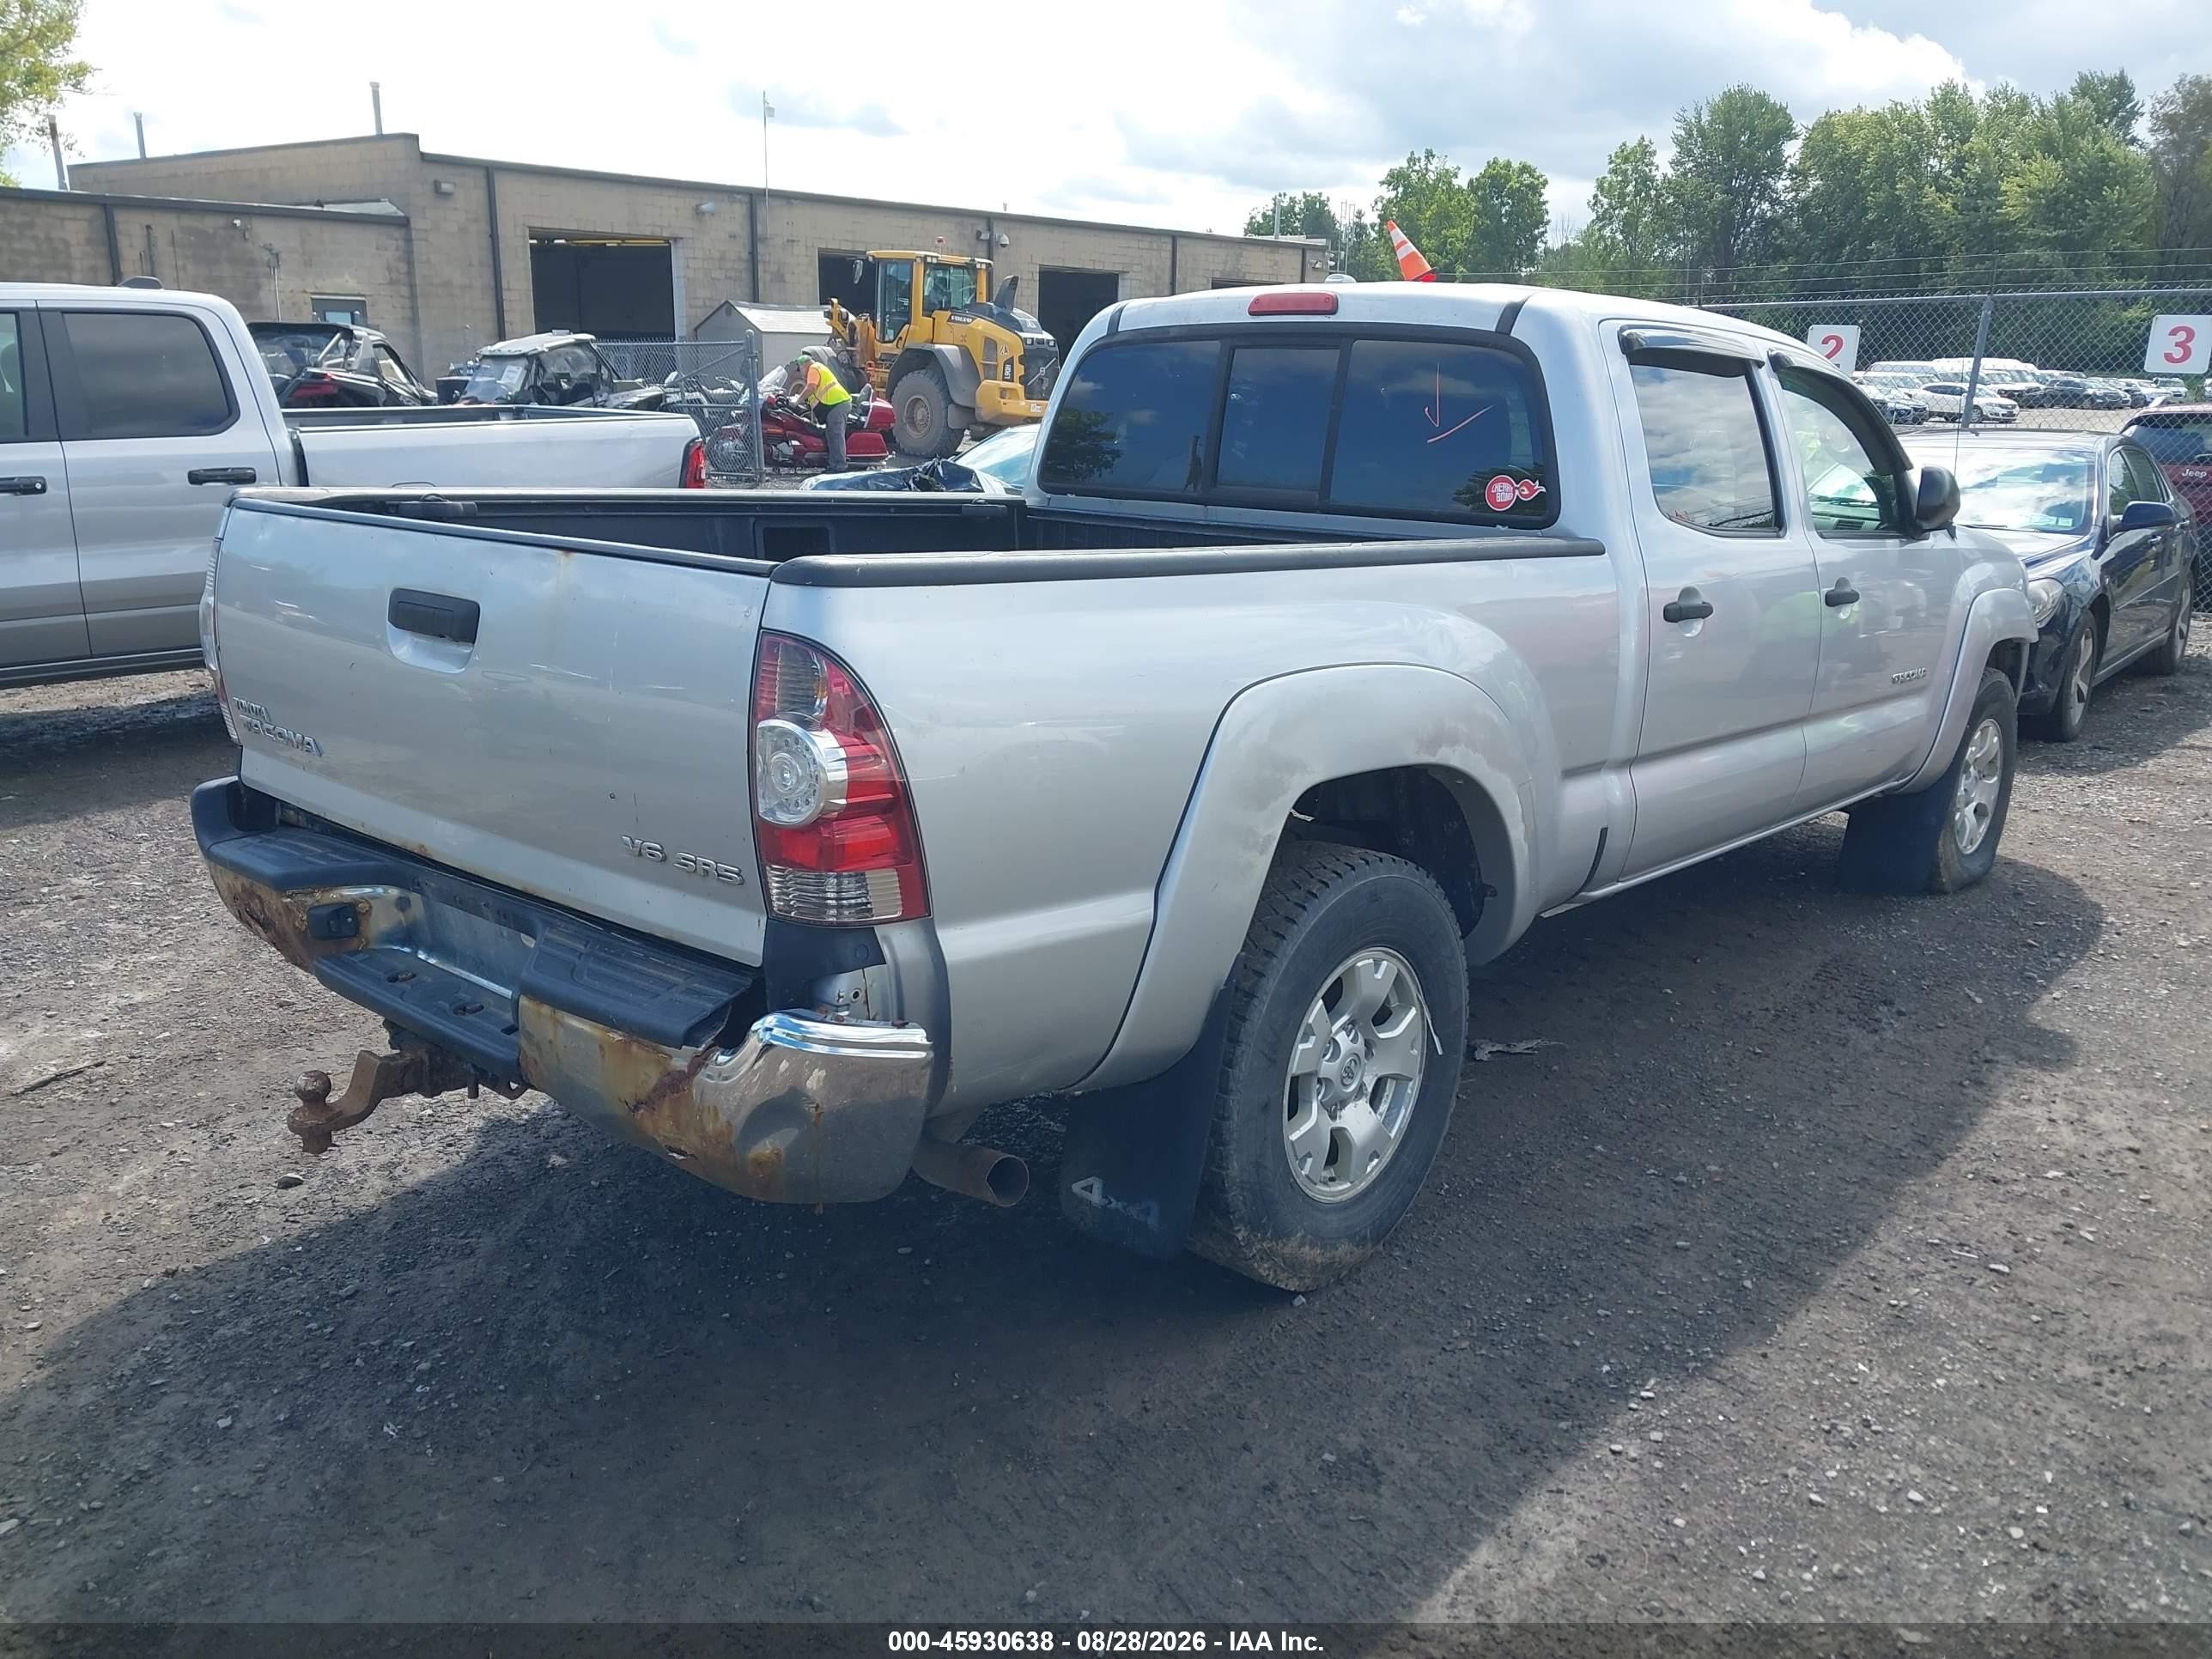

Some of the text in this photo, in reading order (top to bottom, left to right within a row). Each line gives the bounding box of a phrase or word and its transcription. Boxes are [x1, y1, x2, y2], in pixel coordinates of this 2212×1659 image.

[1821, 335, 1844, 359] 2
[2164, 325, 2196, 363] 3
[2182, 468, 2207, 479] Jeep
[1492, 483, 1514, 493] CHERRY
[1496, 493, 1514, 502] BOMB
[233, 696, 271, 721] TOYOTA
[240, 714, 323, 757] TACOMA
[621, 835, 744, 886] V6 SR5
